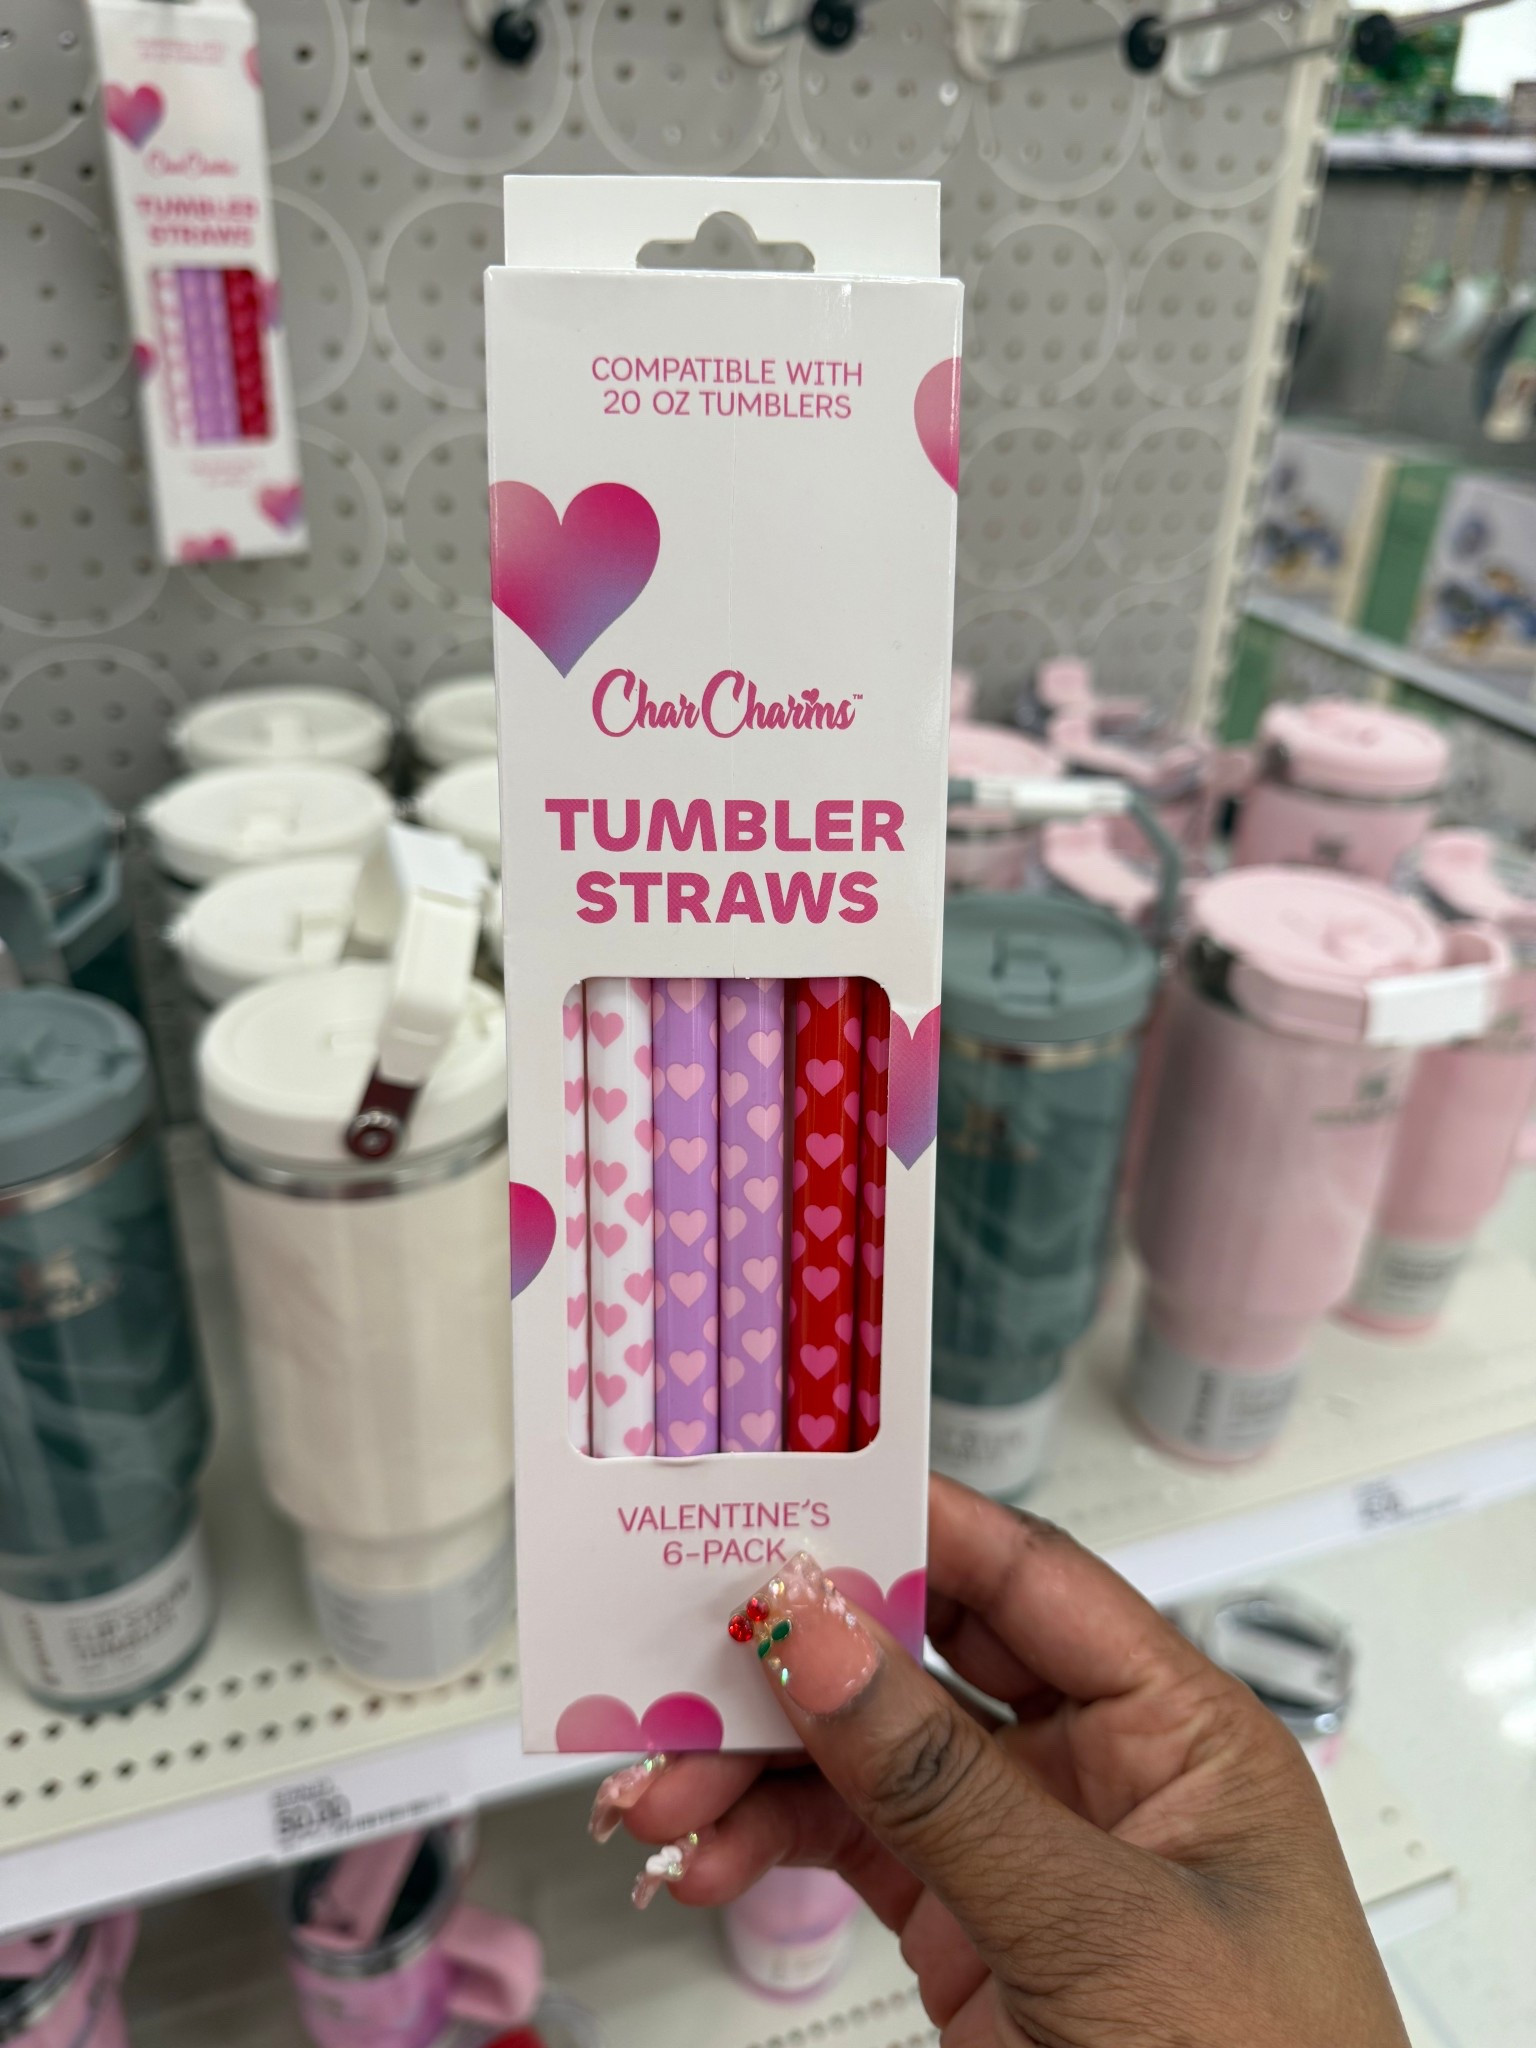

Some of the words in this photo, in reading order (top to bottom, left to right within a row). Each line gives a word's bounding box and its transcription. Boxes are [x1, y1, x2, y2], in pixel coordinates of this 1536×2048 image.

[592, 356, 775, 385] COMPATIBLE
[786, 360, 863, 387] WITH
[603, 389, 641, 416] 20
[652, 390, 690, 416] OZ
[701, 391, 852, 419] TUMBLERS
[544, 799, 905, 853] TUMBLER
[576, 871, 879, 925] STRAWS
[663, 1538, 787, 1566] 6-PACK
